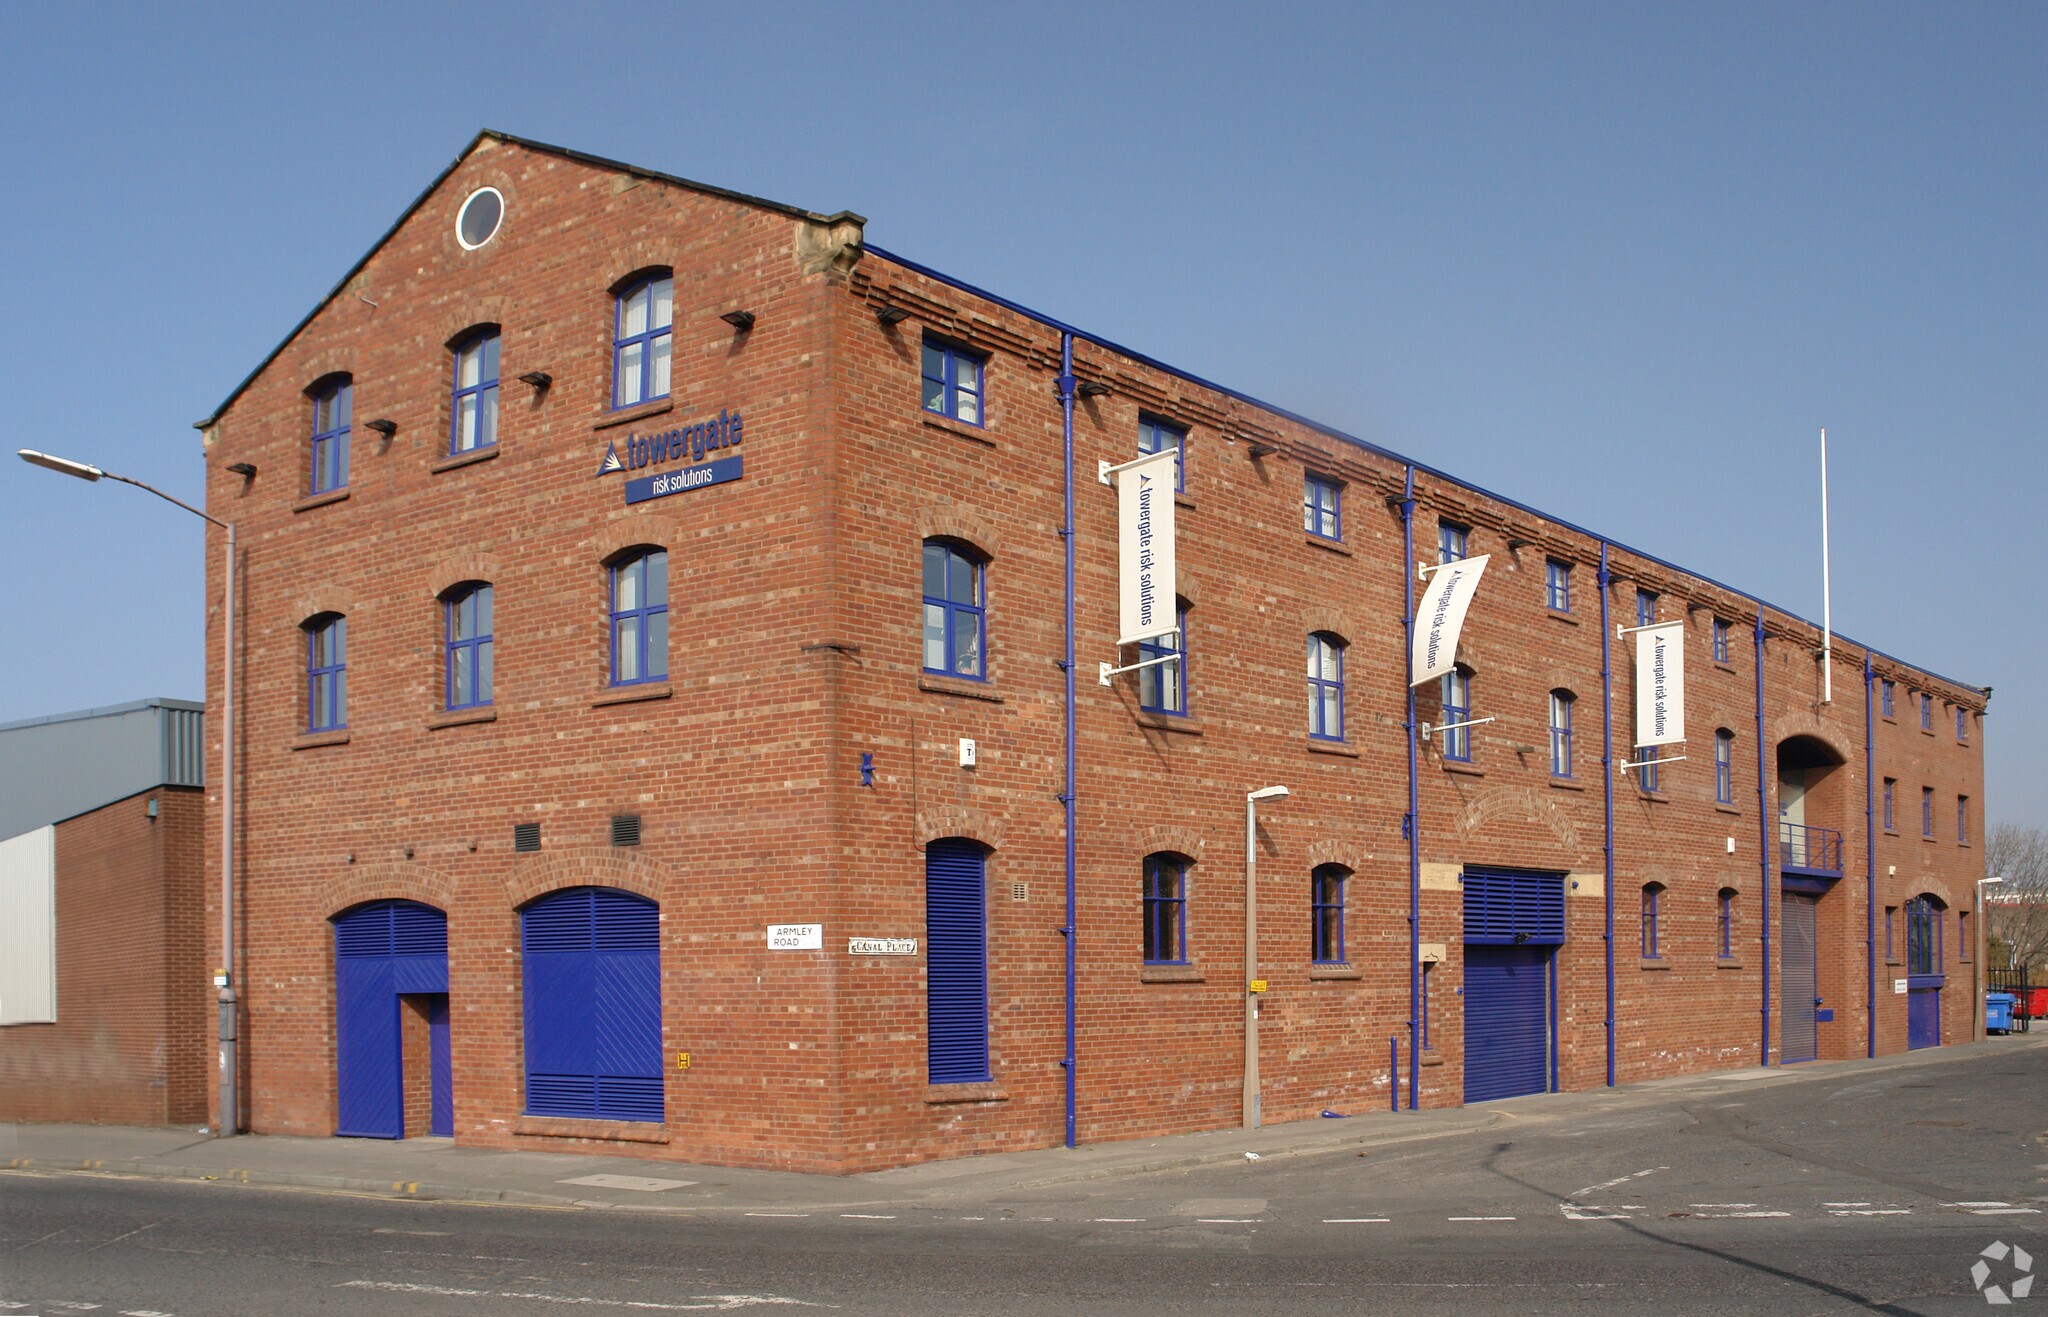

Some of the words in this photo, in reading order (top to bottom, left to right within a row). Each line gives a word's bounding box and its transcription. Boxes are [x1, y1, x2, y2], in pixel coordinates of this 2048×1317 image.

[627, 408, 743, 469] towergate
[653, 475, 670, 495] risk
[671, 468, 712, 490] solutions
[1138, 487, 1154, 547] towergate
[1140, 549, 1155, 572] risk
[1140, 575, 1155, 626] solutions
[1437, 576, 1462, 613] towergate
[1432, 612, 1447, 628] risk
[1427, 630, 1442, 669] solutions
[1653, 645, 1667, 684] towergate
[1655, 685, 1668, 700] risk
[1655, 702, 1668, 737] solutions
[773, 938, 799, 946] ROAD
[776, 927, 812, 936] ARMLEY
